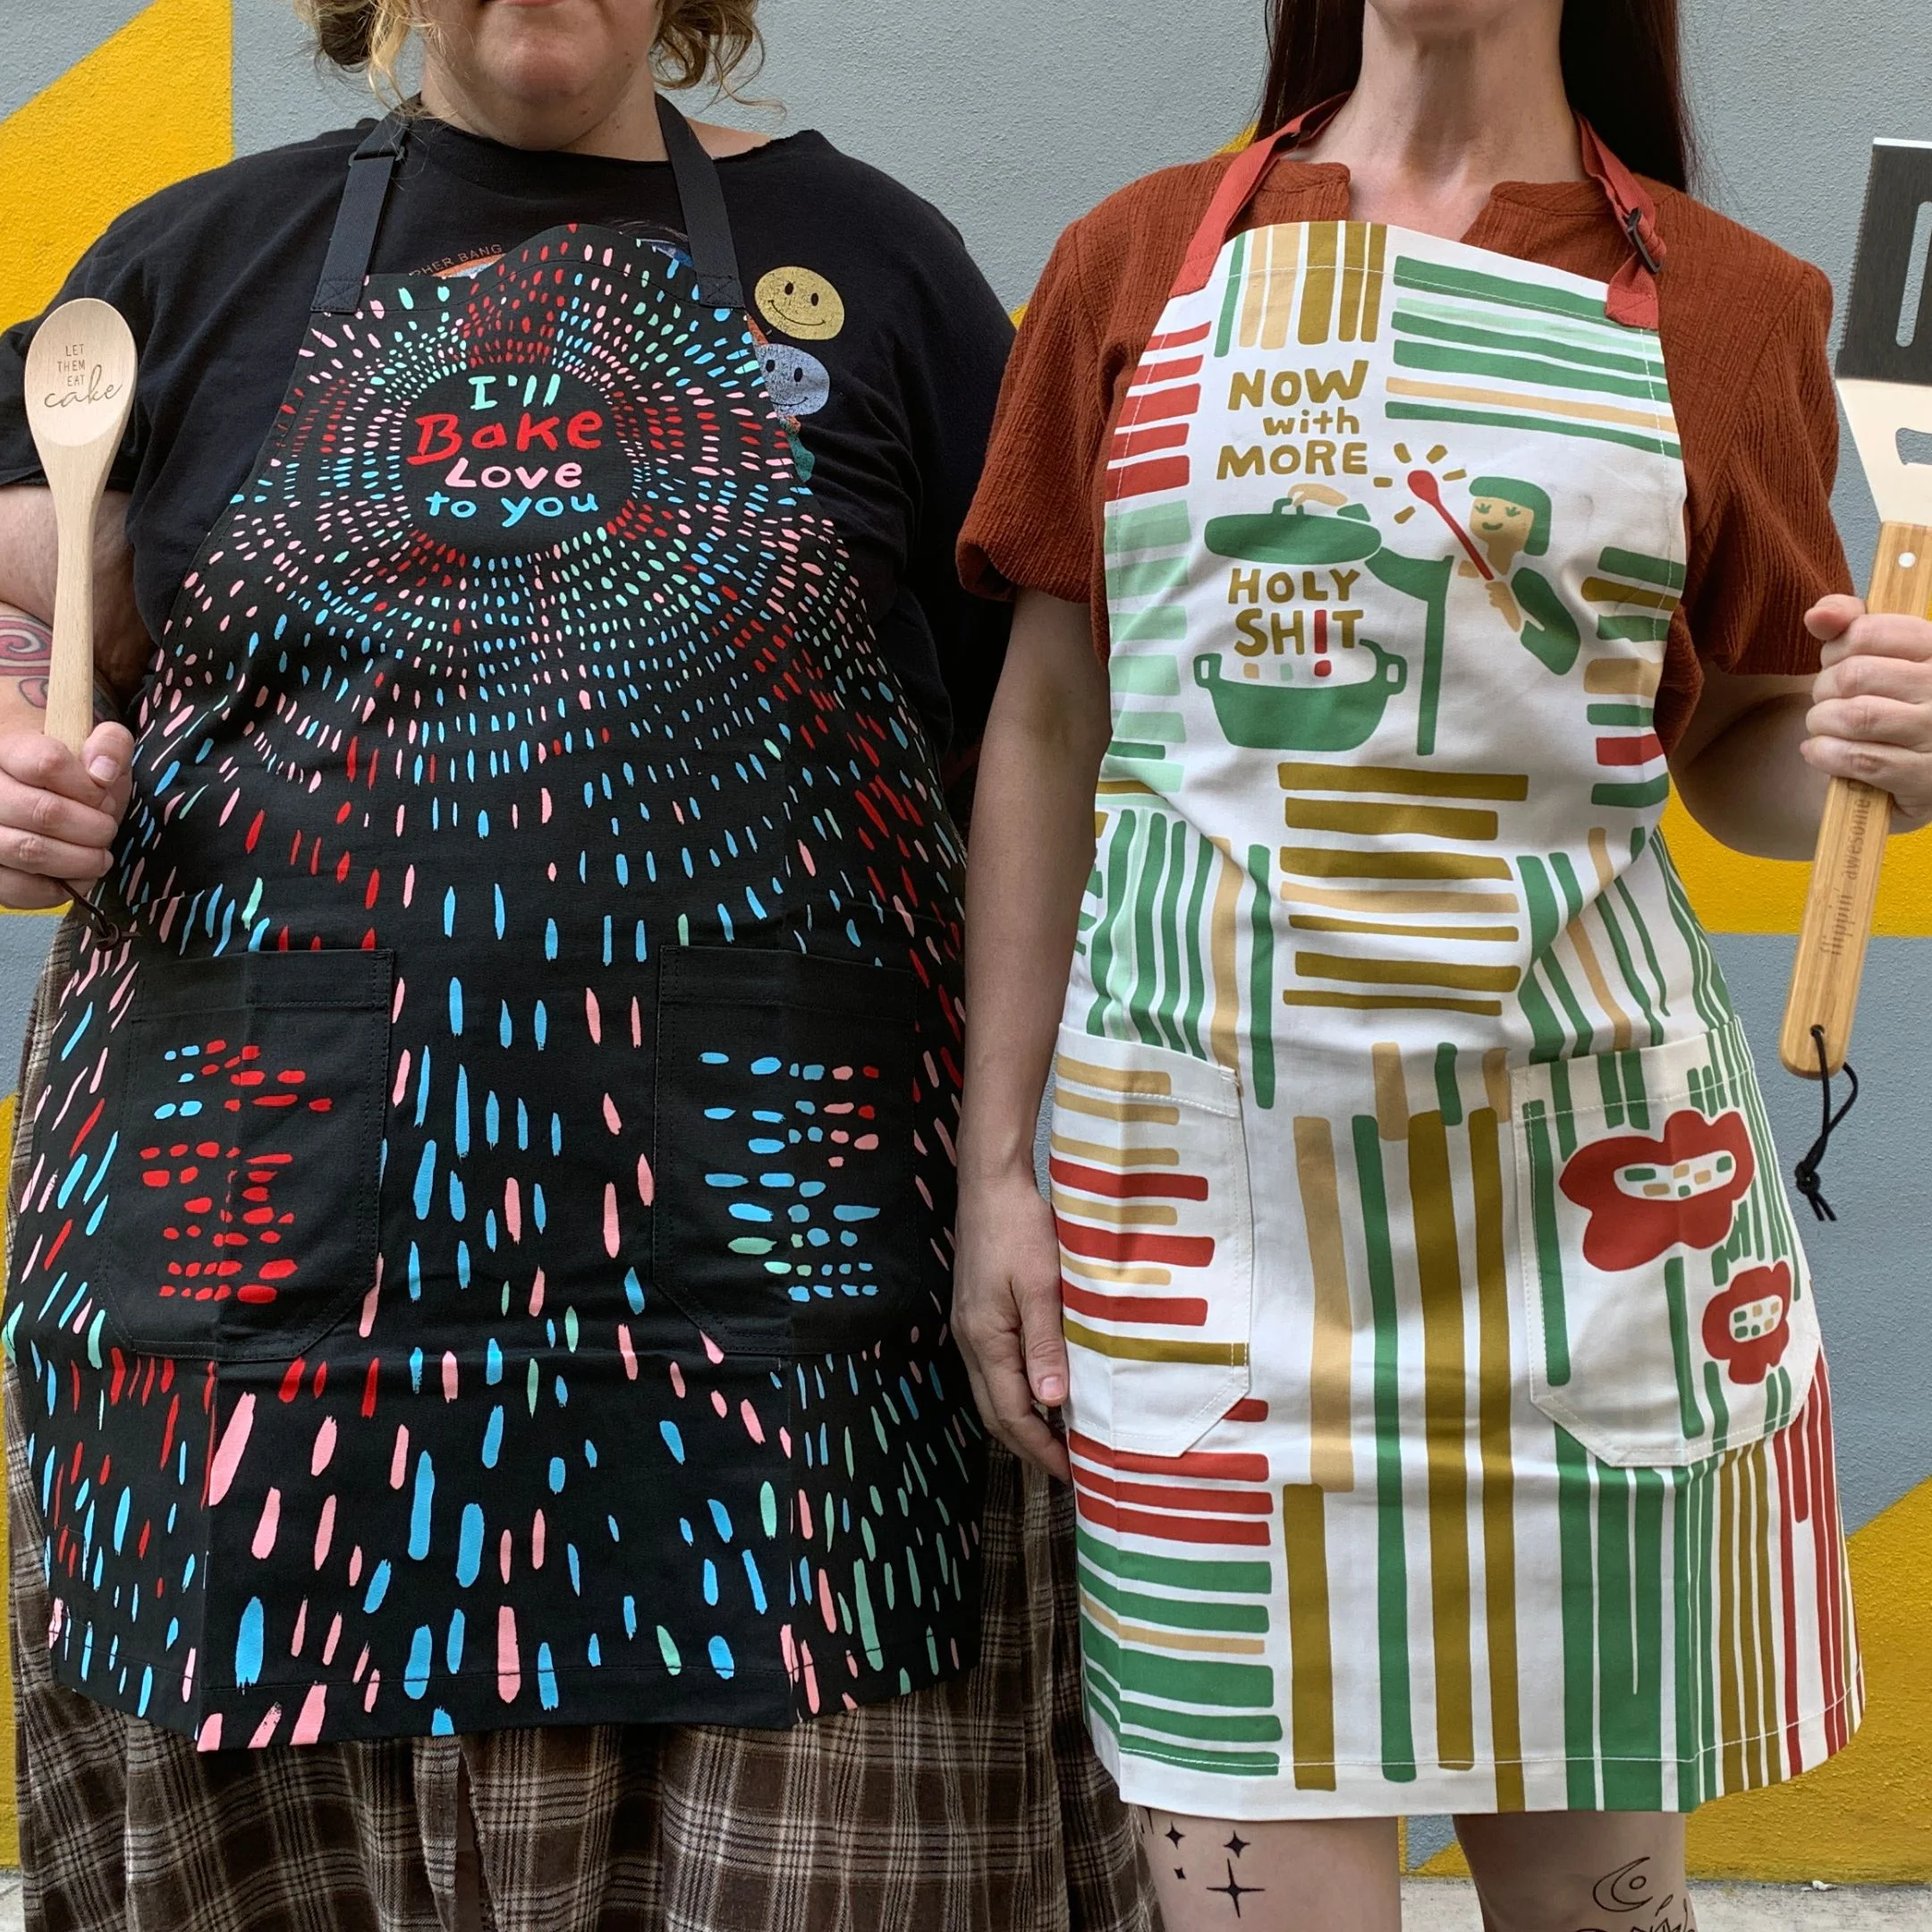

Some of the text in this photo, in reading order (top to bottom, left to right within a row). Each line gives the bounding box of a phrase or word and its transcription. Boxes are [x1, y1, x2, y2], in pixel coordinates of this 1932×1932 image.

[458, 244, 503, 262] BANG
[57, 360, 86, 373] THEM
[65, 343, 85, 357] LET
[44, 364, 123, 408] cake
[67, 375, 85, 386] EAT
[468, 374, 561, 410] I'll
[1227, 360, 1369, 411] NOW
[406, 411, 603, 465] Bake
[1262, 406, 1360, 436] with
[445, 458, 581, 489] Love
[1216, 439, 1368, 479] MORE
[425, 491, 599, 528] to you
[1227, 567, 1360, 605] HOLY
[1233, 607, 1364, 677] SH!T
[1843, 798, 1871, 881] awesome
